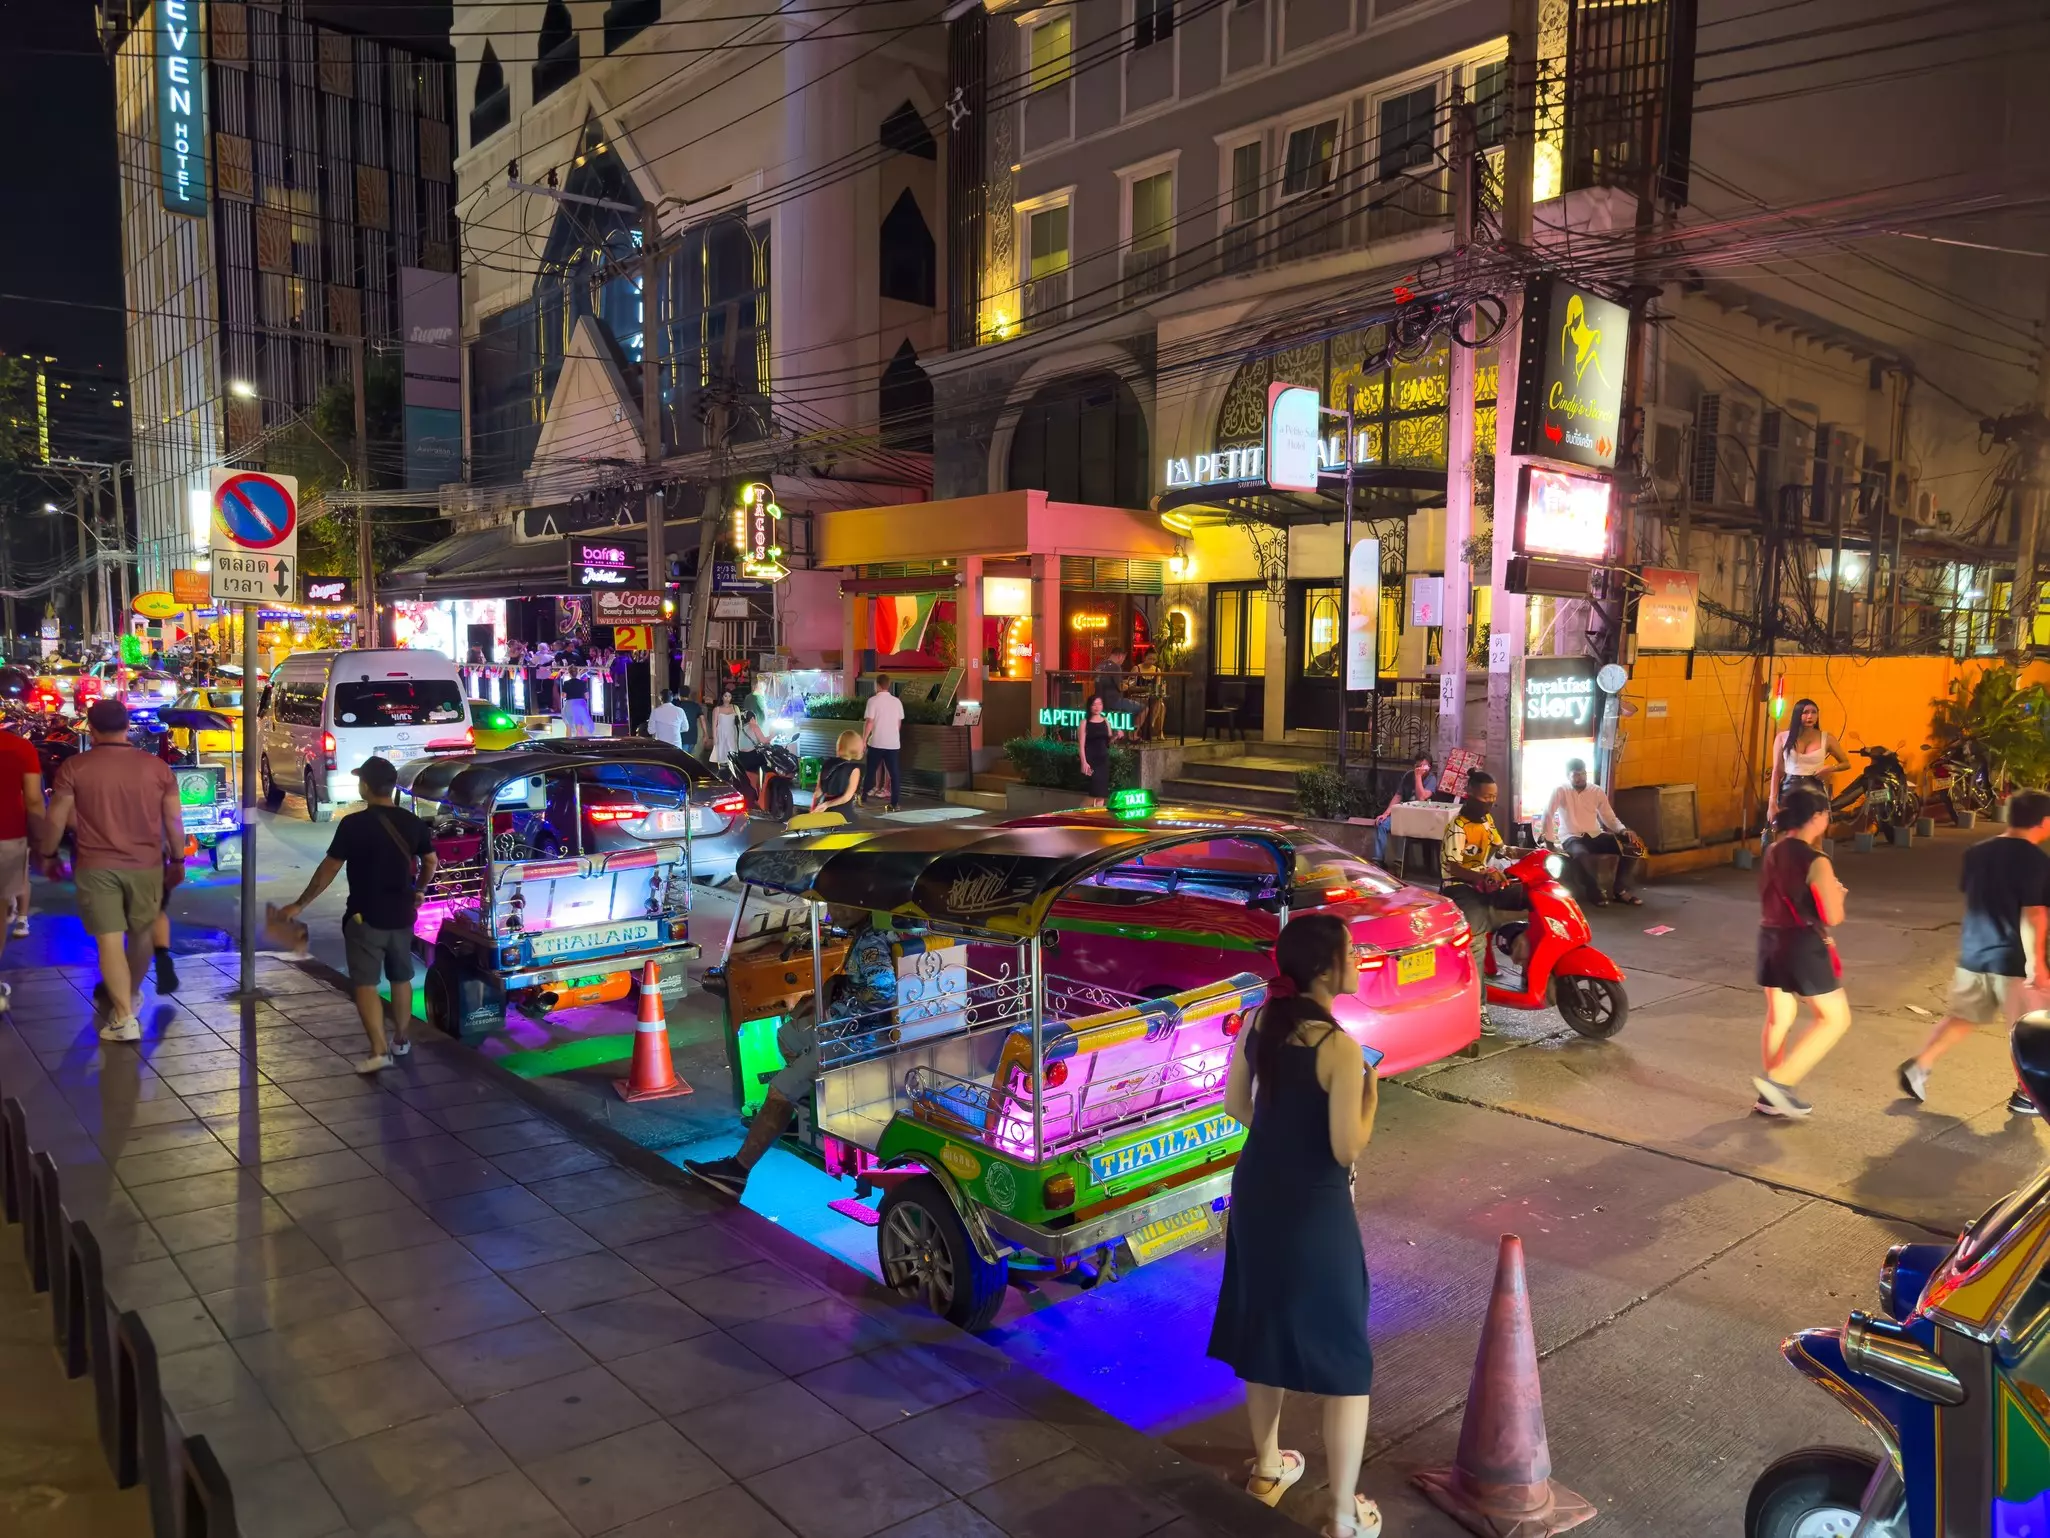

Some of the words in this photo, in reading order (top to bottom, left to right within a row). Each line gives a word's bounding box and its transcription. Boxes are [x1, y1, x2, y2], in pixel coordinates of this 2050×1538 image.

[175, 122, 190, 202] HOTEL
[753, 488, 766, 560] TACOS
[219, 557, 269, 574] ตลอด
[223, 577, 263, 594] เวลา
[619, 591, 661, 608] Lotus
[599, 617, 637, 625] WELCOME
[1072, 613, 1108, 632] Corona
[1492, 651, 1505, 664] 22
[1527, 676, 1593, 695] breakfast
[1527, 695, 1593, 725] story
[1125, 793, 1145, 805] TAXI
[543, 925, 649, 953] THAILAND
[1100, 1115, 1237, 1178] THAILAND
